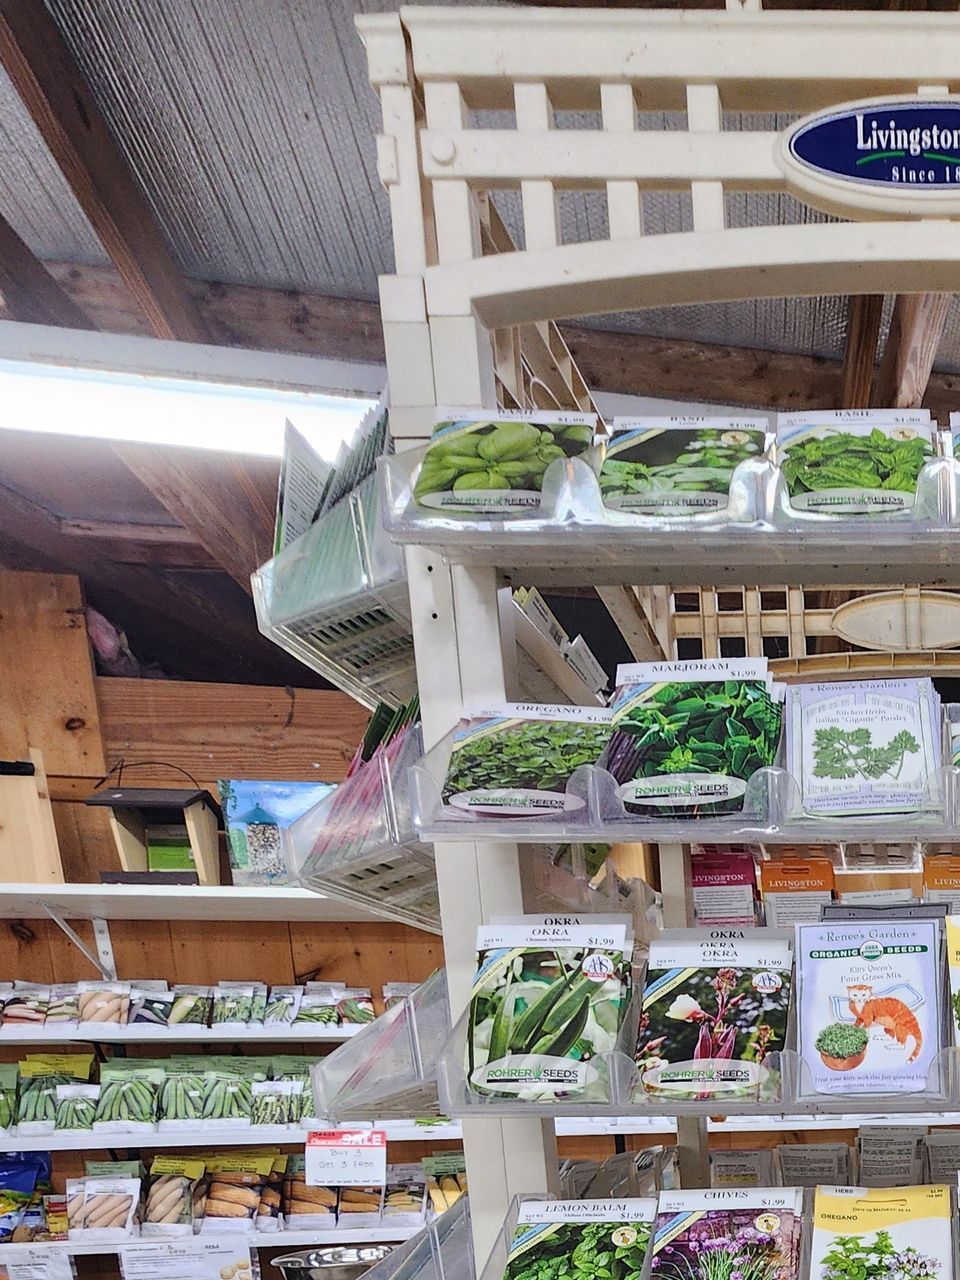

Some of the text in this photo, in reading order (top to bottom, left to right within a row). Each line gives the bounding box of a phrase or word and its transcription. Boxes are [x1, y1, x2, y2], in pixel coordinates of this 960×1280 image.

[891, 166, 936, 182] Since
[652, 661, 730, 673] MARJORAM
[515, 703, 582, 715] OREGANO
[635, 784, 729, 797] ROHRER SEEDS
[528, 798, 566, 807] SEEDS
[769, 880, 825, 888] LIVINGSTON
[544, 917, 581, 927] OKRA
[532, 928, 570, 937] OKRA
[710, 930, 745, 939] OKRA
[825, 929, 910, 942] Renee's Garden
[588, 938, 614, 946] $1.99
[702, 949, 739, 958] OKRA
[811, 945, 922, 959] ORGANIC SEEDS
[757, 958, 782, 967] $1.99
[487, 1068, 579, 1079] ROHRER SEEDS
[661, 1069, 750, 1080] ROHRER SEEDS
[704, 1190, 749, 1200] CHIVES
[545, 1203, 627, 1213] LEMON BALM
[621, 1212, 645, 1220] $1.99
[820, 1213, 858, 1221] OREGANO
